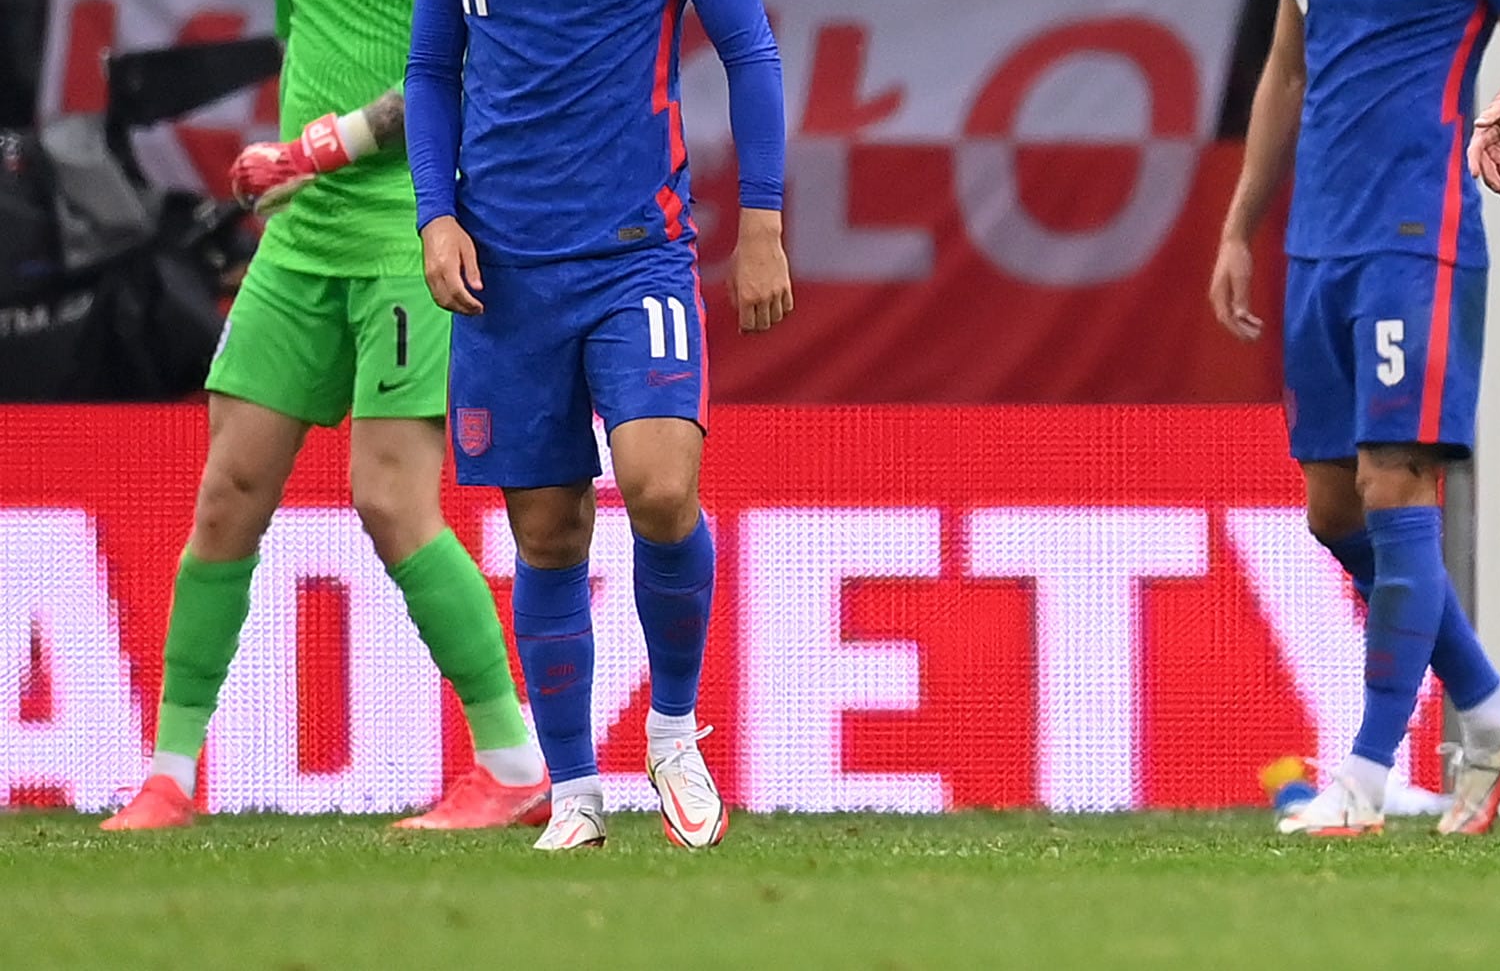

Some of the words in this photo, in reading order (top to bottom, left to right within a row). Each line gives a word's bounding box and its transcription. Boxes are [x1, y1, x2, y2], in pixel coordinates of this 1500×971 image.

[308, 122, 338, 153] JP
[392, 306, 407, 367] 1
[642, 296, 689, 361] 11
[1375, 319, 1405, 387] 5
